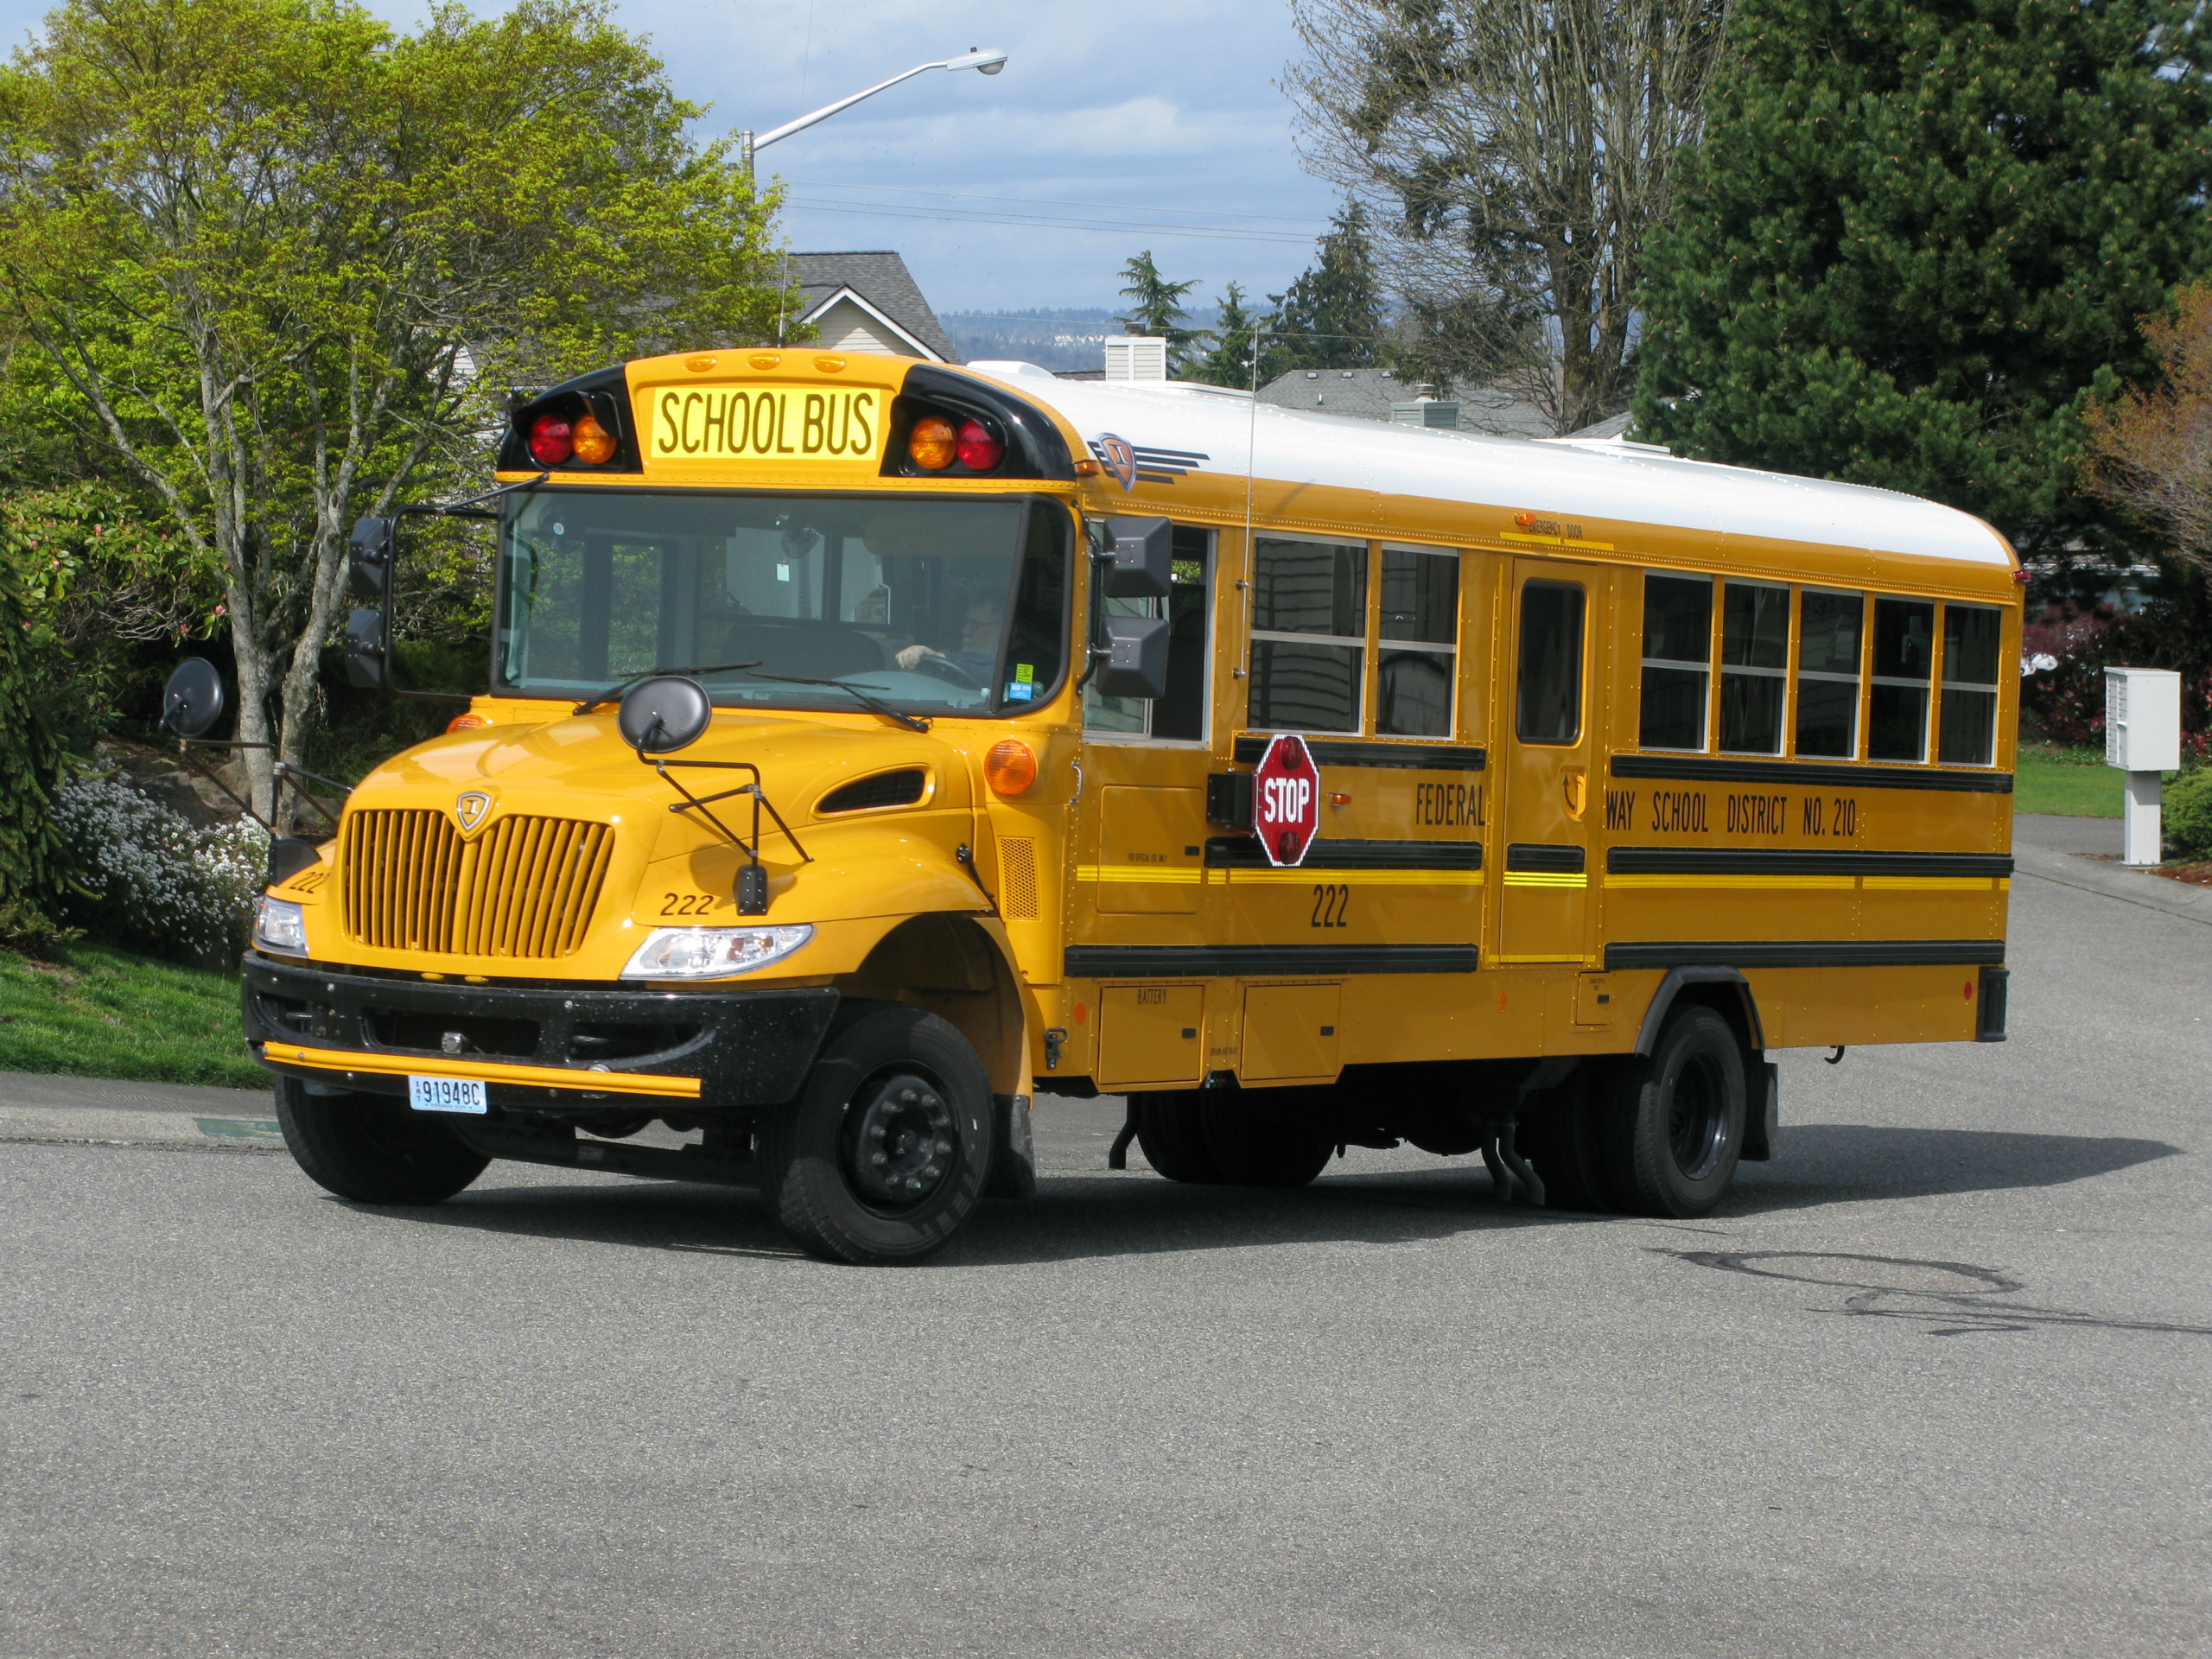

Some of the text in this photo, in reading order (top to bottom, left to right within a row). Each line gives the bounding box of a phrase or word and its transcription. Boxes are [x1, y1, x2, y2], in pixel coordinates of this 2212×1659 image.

[658, 391, 873, 454] SCHOOL BUS
[1567, 524, 1583, 539] DOOR
[1263, 778, 1310, 823] STOP
[1416, 783, 1856, 836] FEDERAL WAY SCHOOL DISTRICT NO. 210
[289, 871, 332, 894] 222
[660, 893, 714, 916] 222
[1311, 884, 1349, 928] 222
[1138, 988, 1167, 1004] BATTERY
[423, 1080, 480, 1106] 91948C
